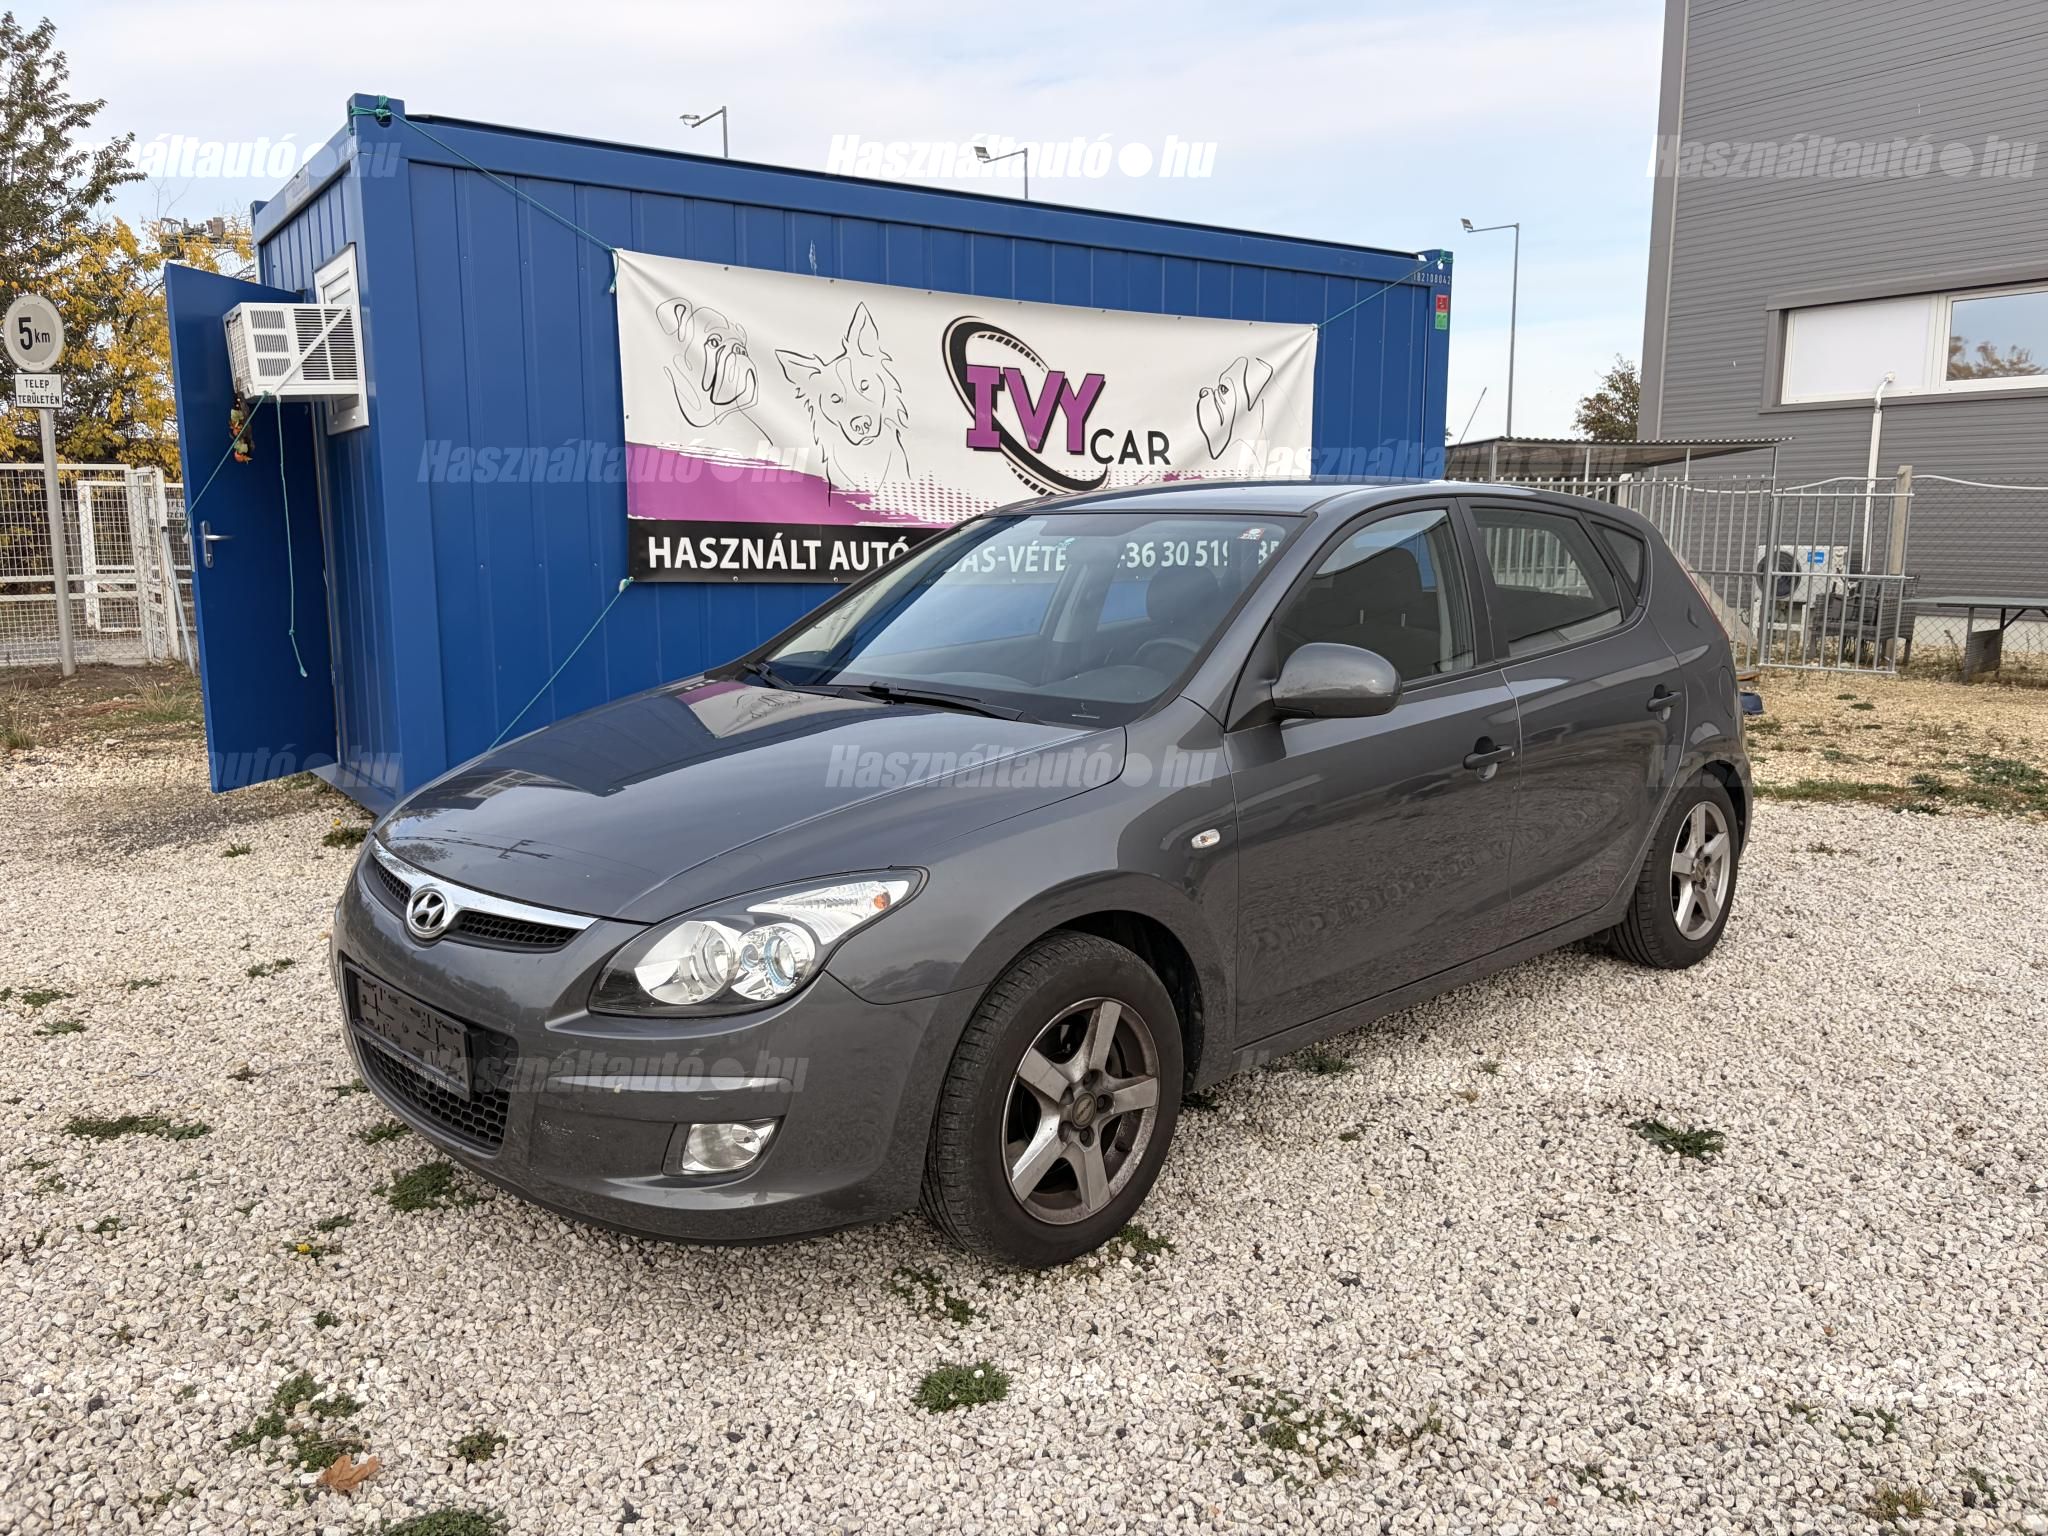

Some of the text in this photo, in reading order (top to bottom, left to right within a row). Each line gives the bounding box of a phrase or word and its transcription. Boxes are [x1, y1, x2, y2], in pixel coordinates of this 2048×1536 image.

[18, 317, 50, 350] 5 km
[17, 392, 60, 404] TERÜLETÉN
[24, 379, 50, 389] TELEP
[966, 364, 1171, 465] IVY CAR
[648, 532, 821, 570] HASZNÁLT
[829, 536, 909, 570] AUTÓ
[1120, 541, 1156, 568] 36
[1161, 541, 1189, 567] 30
